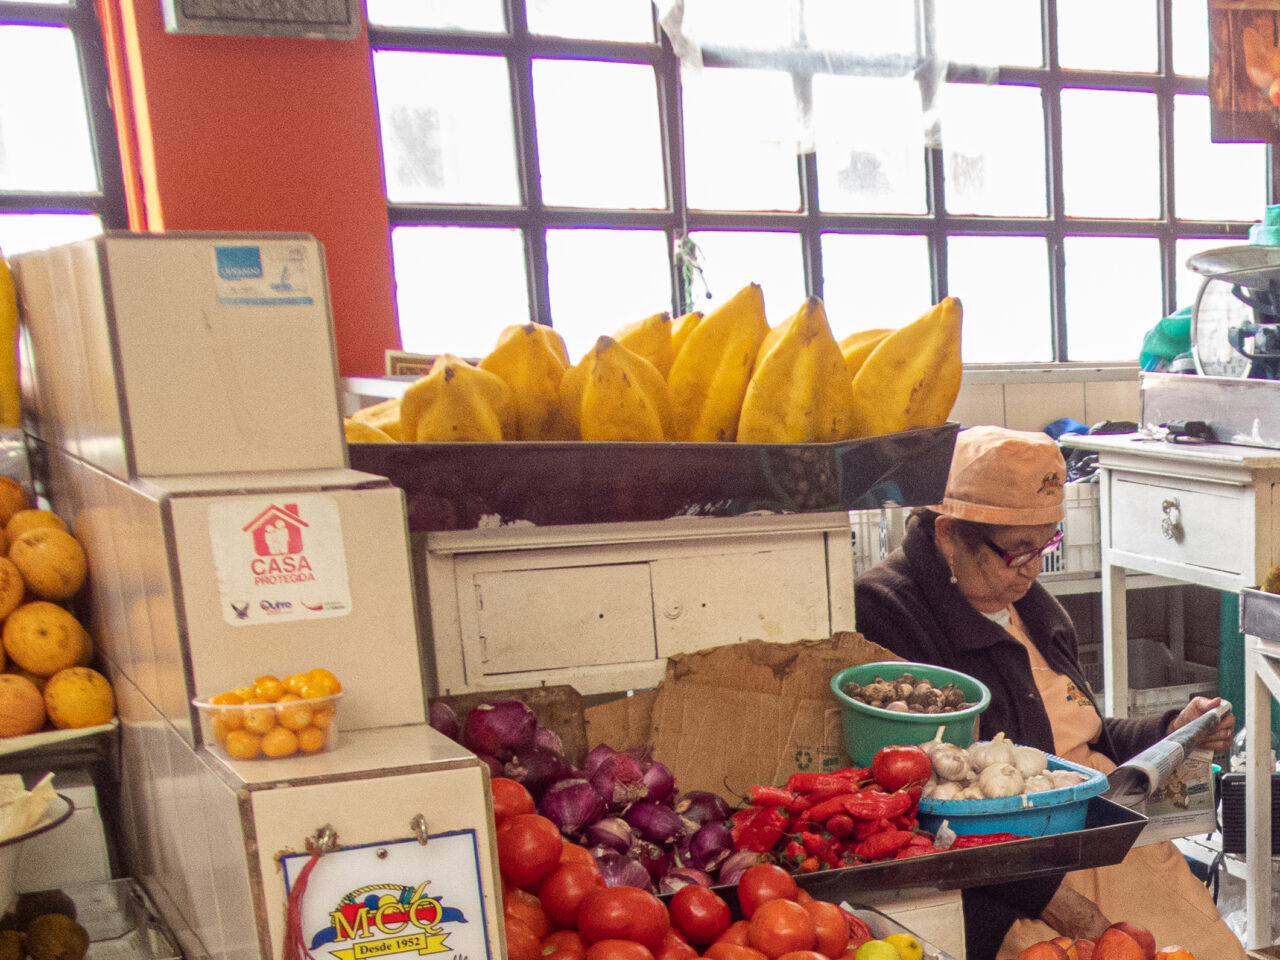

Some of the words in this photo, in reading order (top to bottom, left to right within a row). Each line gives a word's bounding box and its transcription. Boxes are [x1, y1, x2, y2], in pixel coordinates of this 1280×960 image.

[251, 555, 312, 576] CASA
[254, 573, 316, 586] PROTEGIDA
[329, 898, 444, 943] MCQ
[359, 939, 393, 955] Desde
[396, 936, 421, 951] 1952
